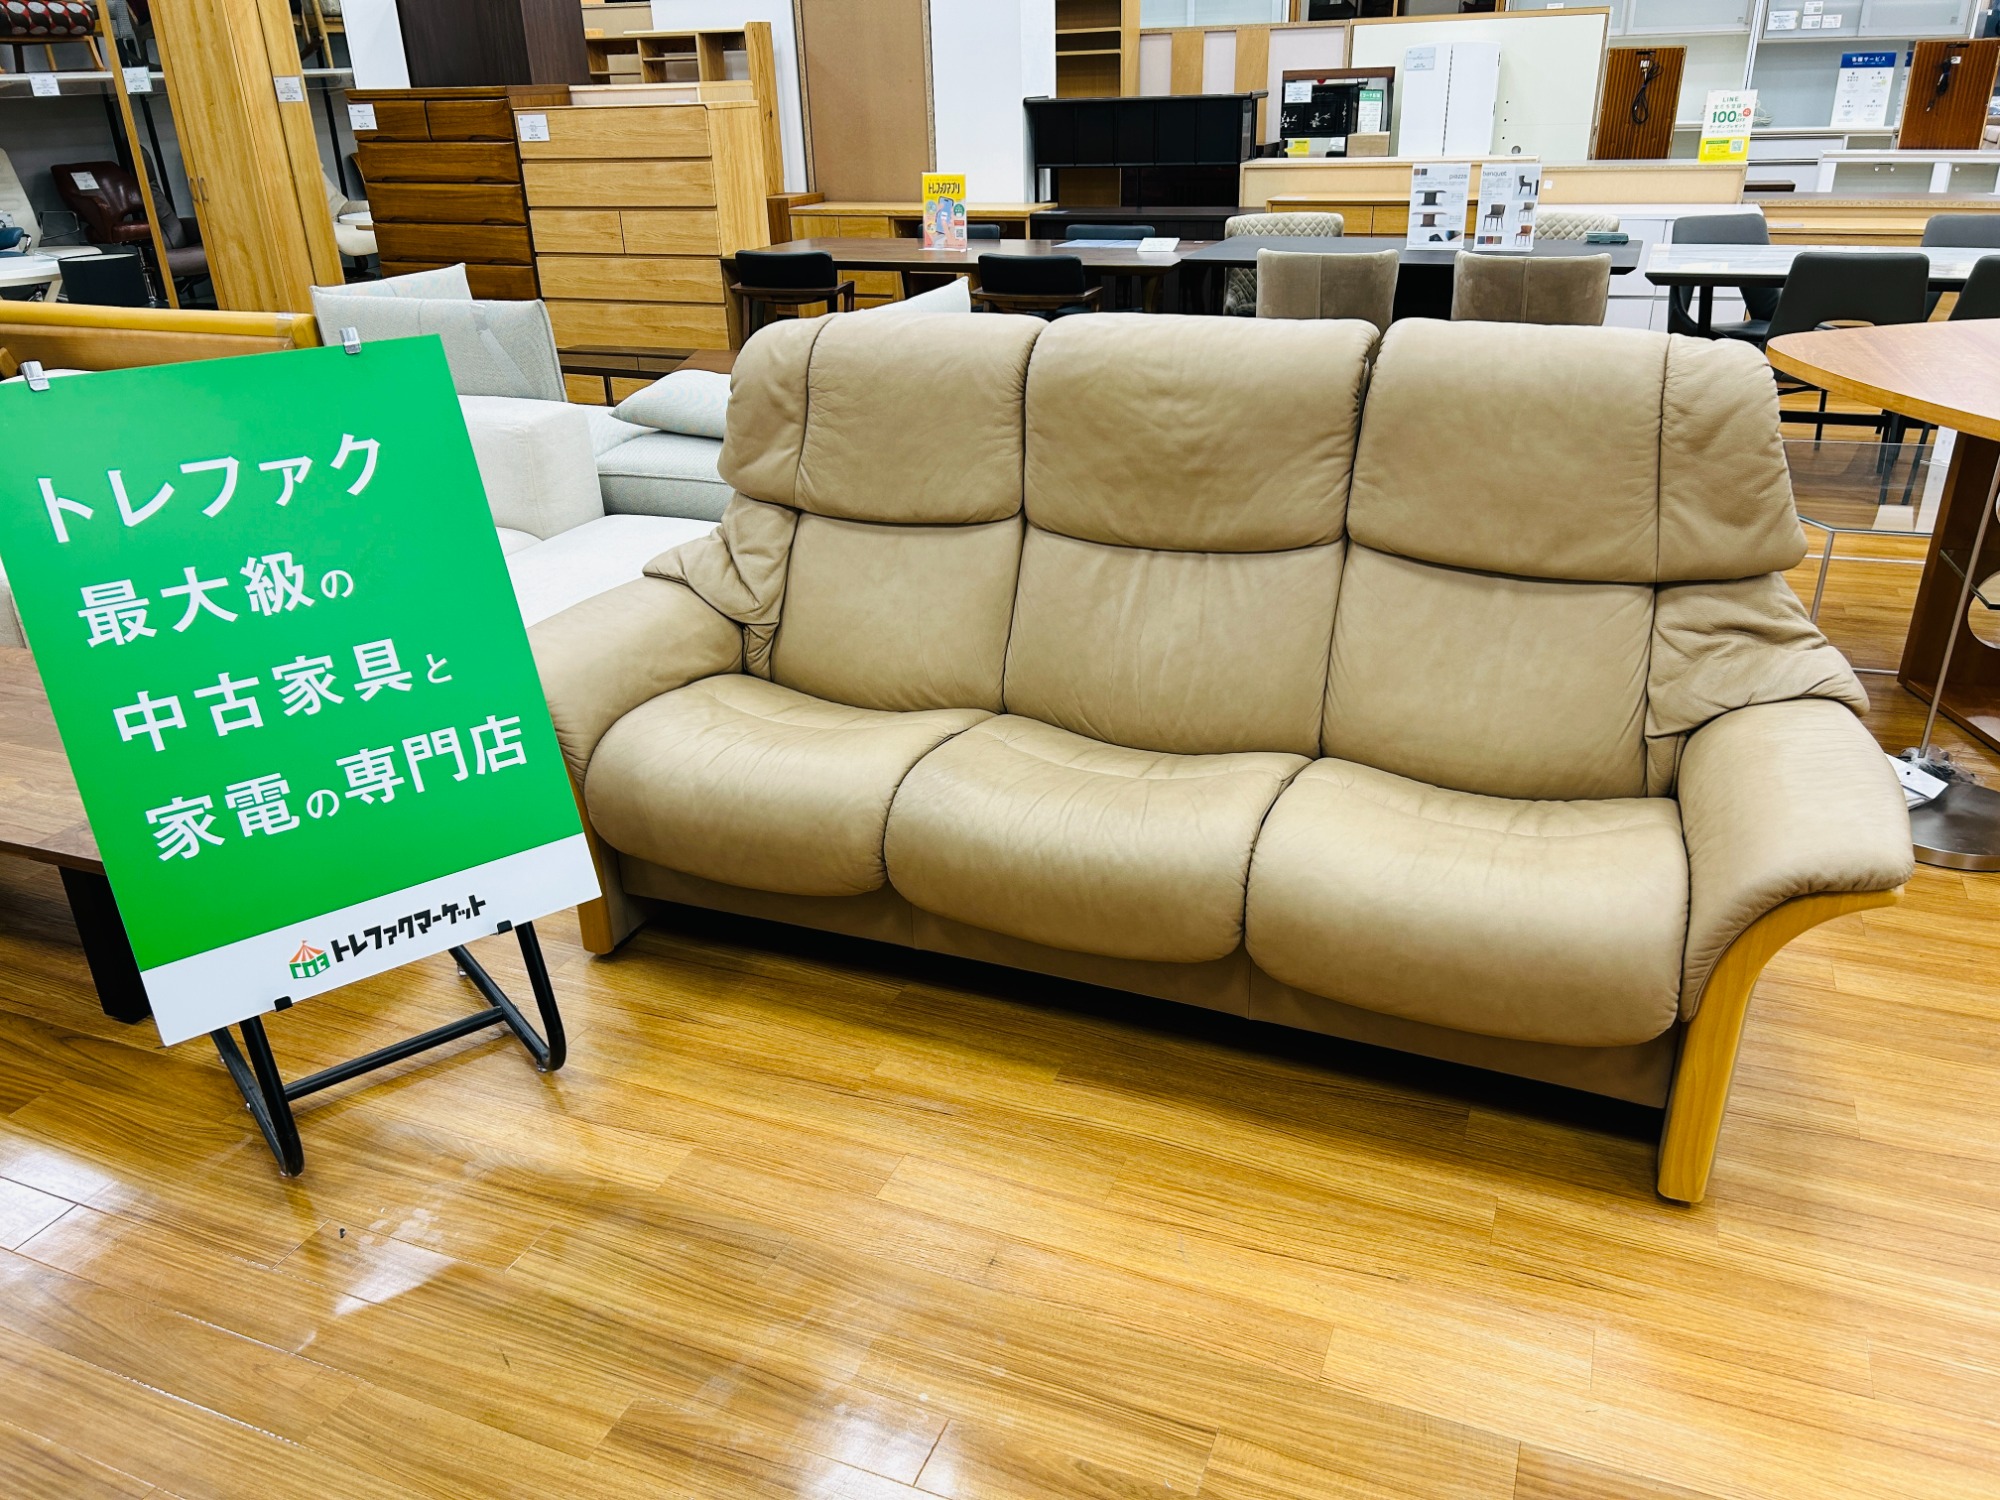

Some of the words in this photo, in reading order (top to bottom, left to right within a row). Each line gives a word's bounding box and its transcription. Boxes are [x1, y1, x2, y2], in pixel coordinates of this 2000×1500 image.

[37, 433, 381, 543] トレファク
[77, 552, 354, 648] 最大級の
[113, 638, 452, 752] 中古家具と
[145, 715, 527, 861] 家電の専門店
[330, 894, 486, 963] トレファクマーケット
